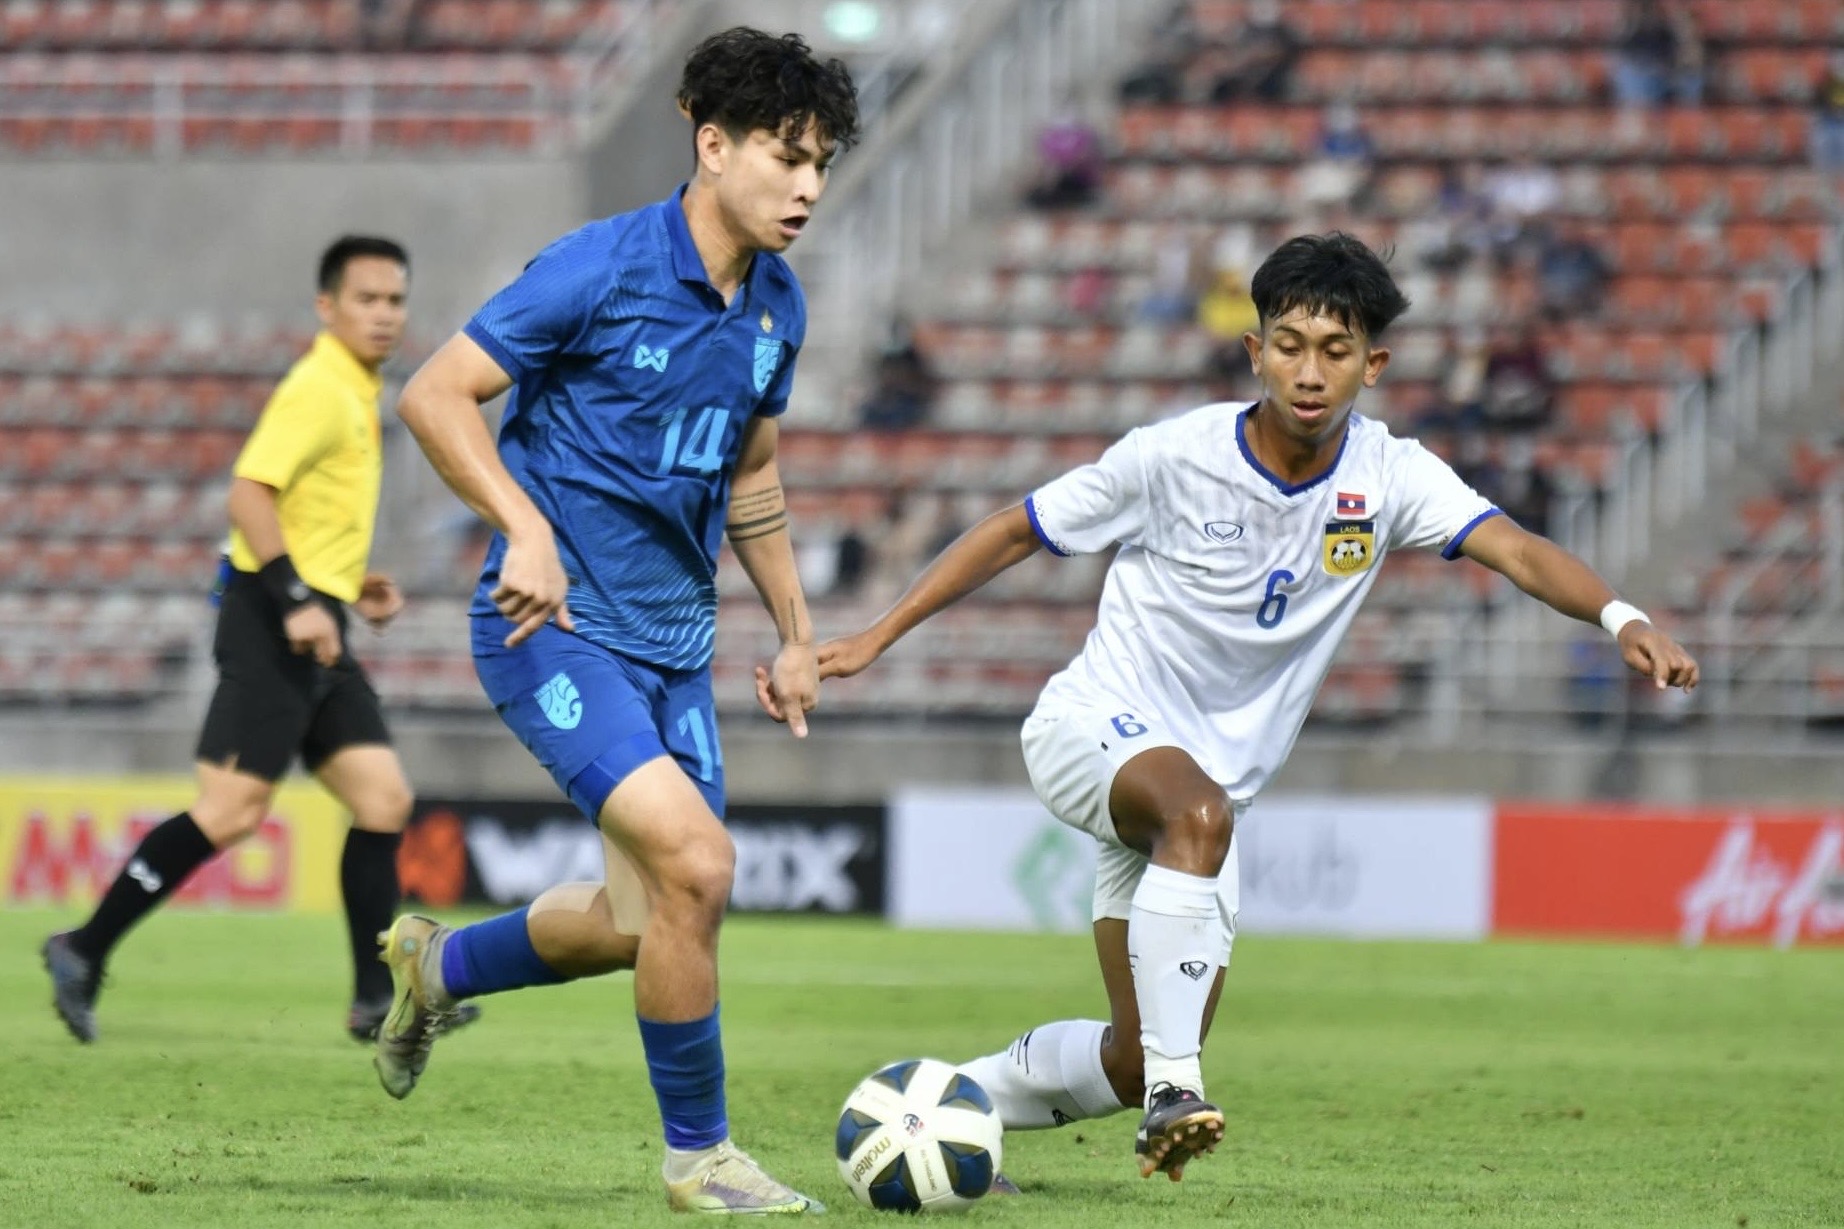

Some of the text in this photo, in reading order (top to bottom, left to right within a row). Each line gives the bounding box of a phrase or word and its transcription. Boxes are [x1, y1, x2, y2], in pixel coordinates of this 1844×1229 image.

[656, 406, 730, 476] 14
[1340, 525, 1361, 534] LAOS
[1256, 569, 1295, 630] 6
[678, 702, 722, 782] 1
[1110, 712, 1149, 739] 6
[852, 1136, 892, 1183] molten
